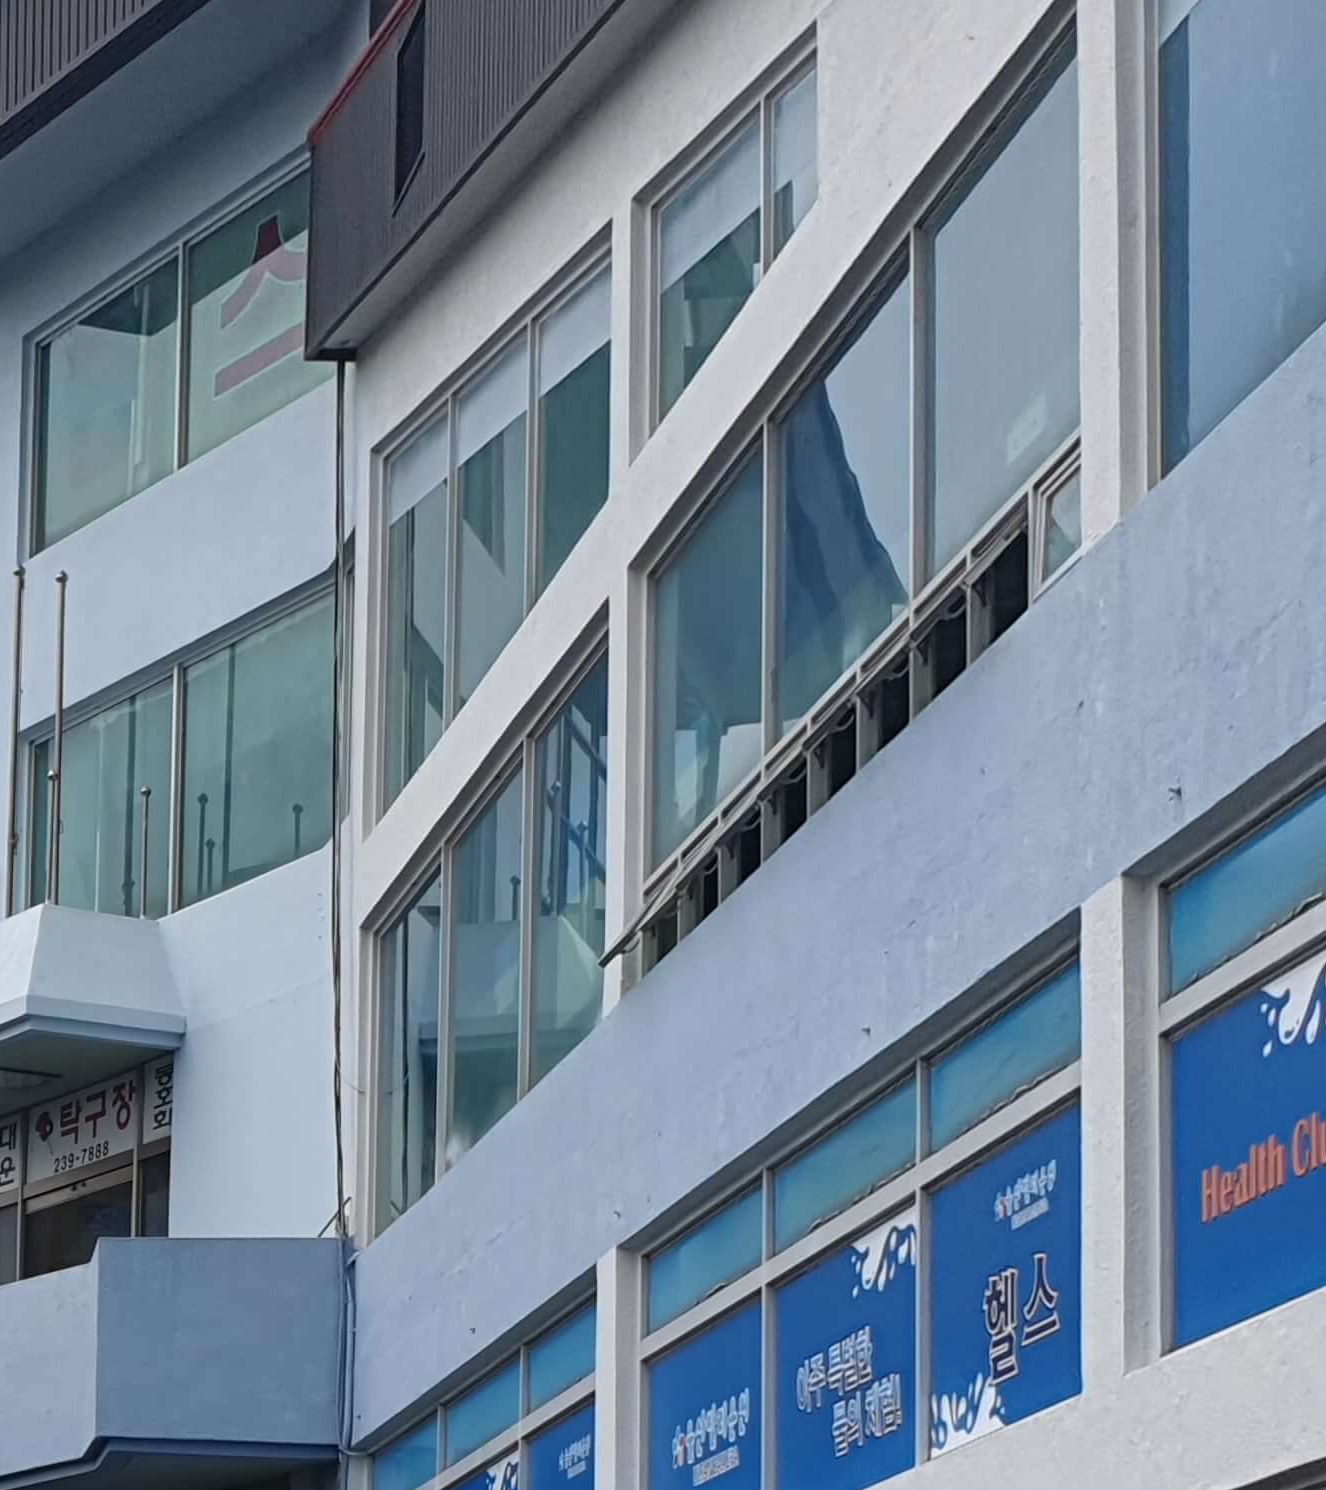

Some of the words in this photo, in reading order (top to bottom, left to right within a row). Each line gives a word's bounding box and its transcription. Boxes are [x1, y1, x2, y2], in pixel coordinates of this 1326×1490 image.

[60, 1080, 136, 1145] 탁구장
[53, 1141, 110, 1173] 239-7888
[1201, 1134, 1287, 1224] Health
[984, 1252, 1061, 1387] 헬스
[796, 1352, 827, 1414] 아주
